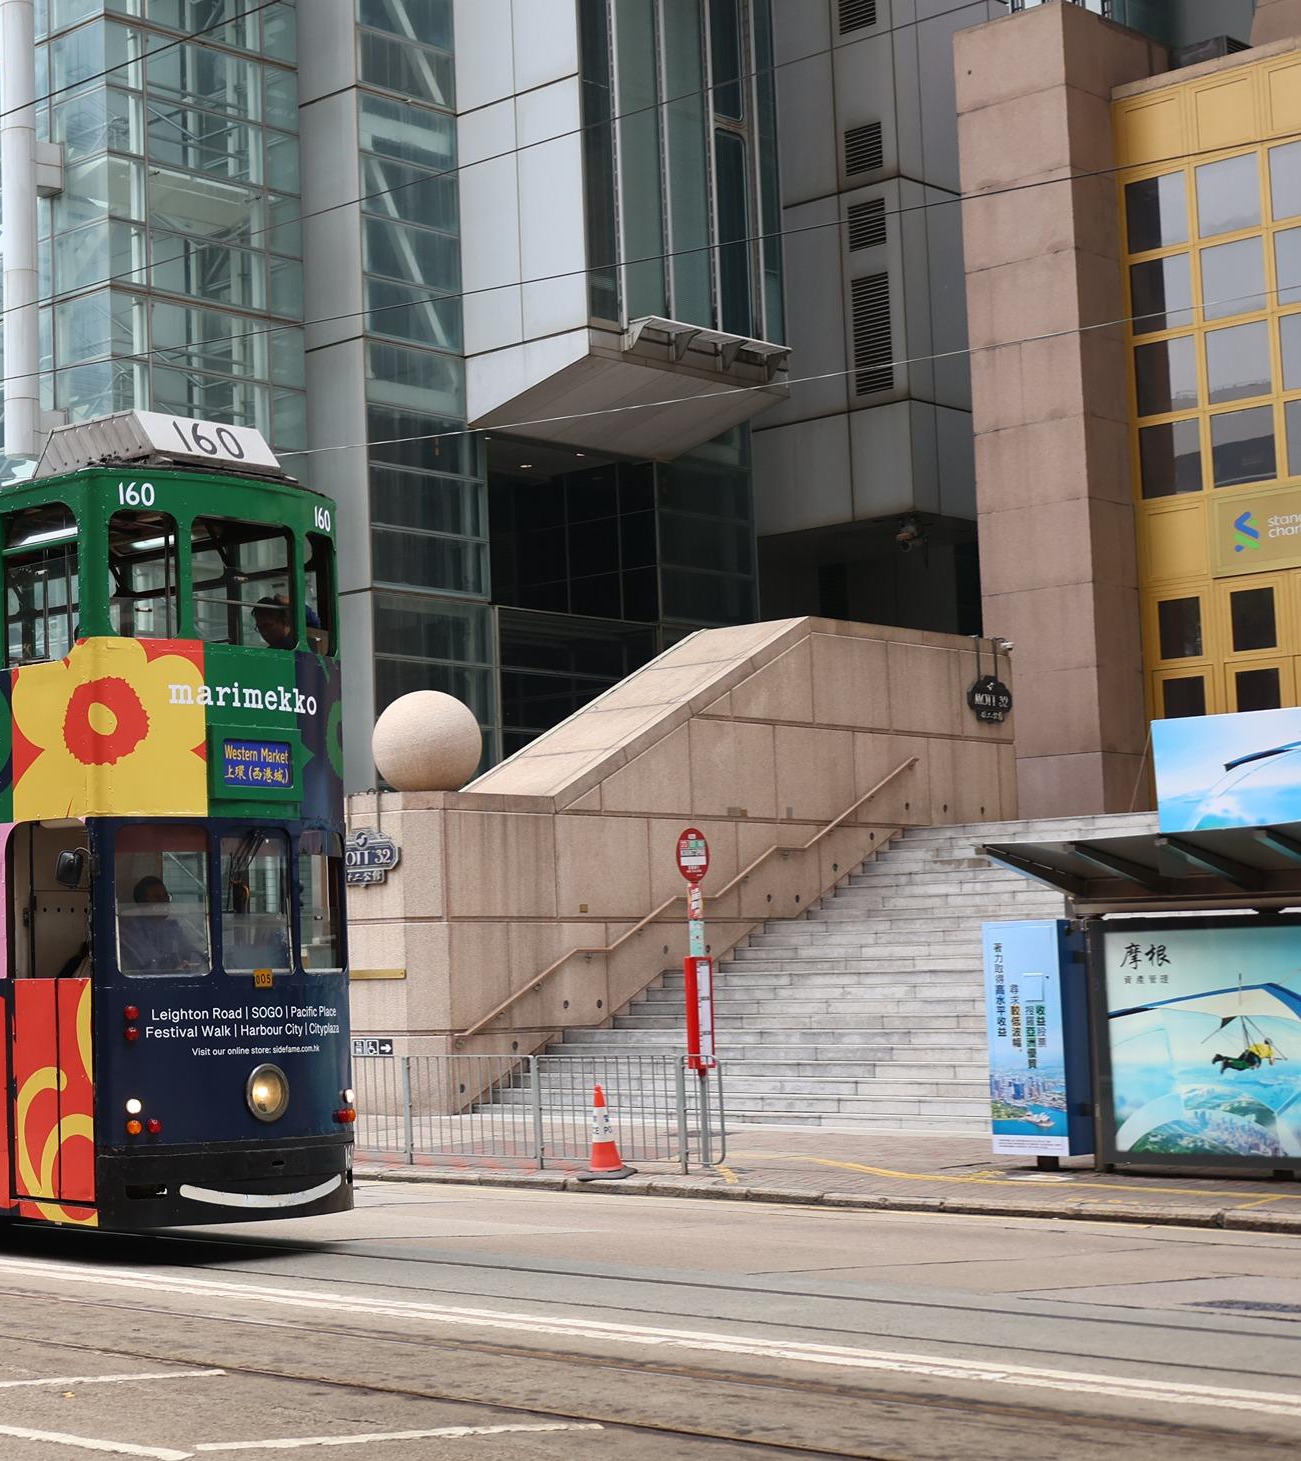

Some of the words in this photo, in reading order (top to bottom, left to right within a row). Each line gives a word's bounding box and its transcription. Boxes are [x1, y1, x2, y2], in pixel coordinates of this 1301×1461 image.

[172, 420, 244, 459] 160
[118, 481, 155, 507] 160
[314, 505, 331, 532] 160
[168, 682, 318, 715] marimekko
[224, 744, 258, 761] Western
[260, 747, 289, 764] Market
[346, 849, 370, 866] OTT
[374, 848, 391, 864] 32
[1119, 942, 1172, 970] 摩根
[151, 1008, 209, 1023] Leighton
[212, 1007, 243, 1019] Road
[251, 1006, 284, 1019] SOGO
[290, 1005, 318, 1018] Pacific
[319, 1005, 337, 1017] Place
[145, 1025, 198, 1038] Festival
[201, 1024, 231, 1037] Walk
[240, 1023, 283, 1036] Harbour
[285, 1023, 303, 1037] City
[309, 1022, 340, 1037] Cityplaza
[191, 1047, 211, 1056] Visit
[212, 1048, 226, 1056] our
[227, 1046, 250, 1055] online
[251, 1046, 271, 1055] store:
